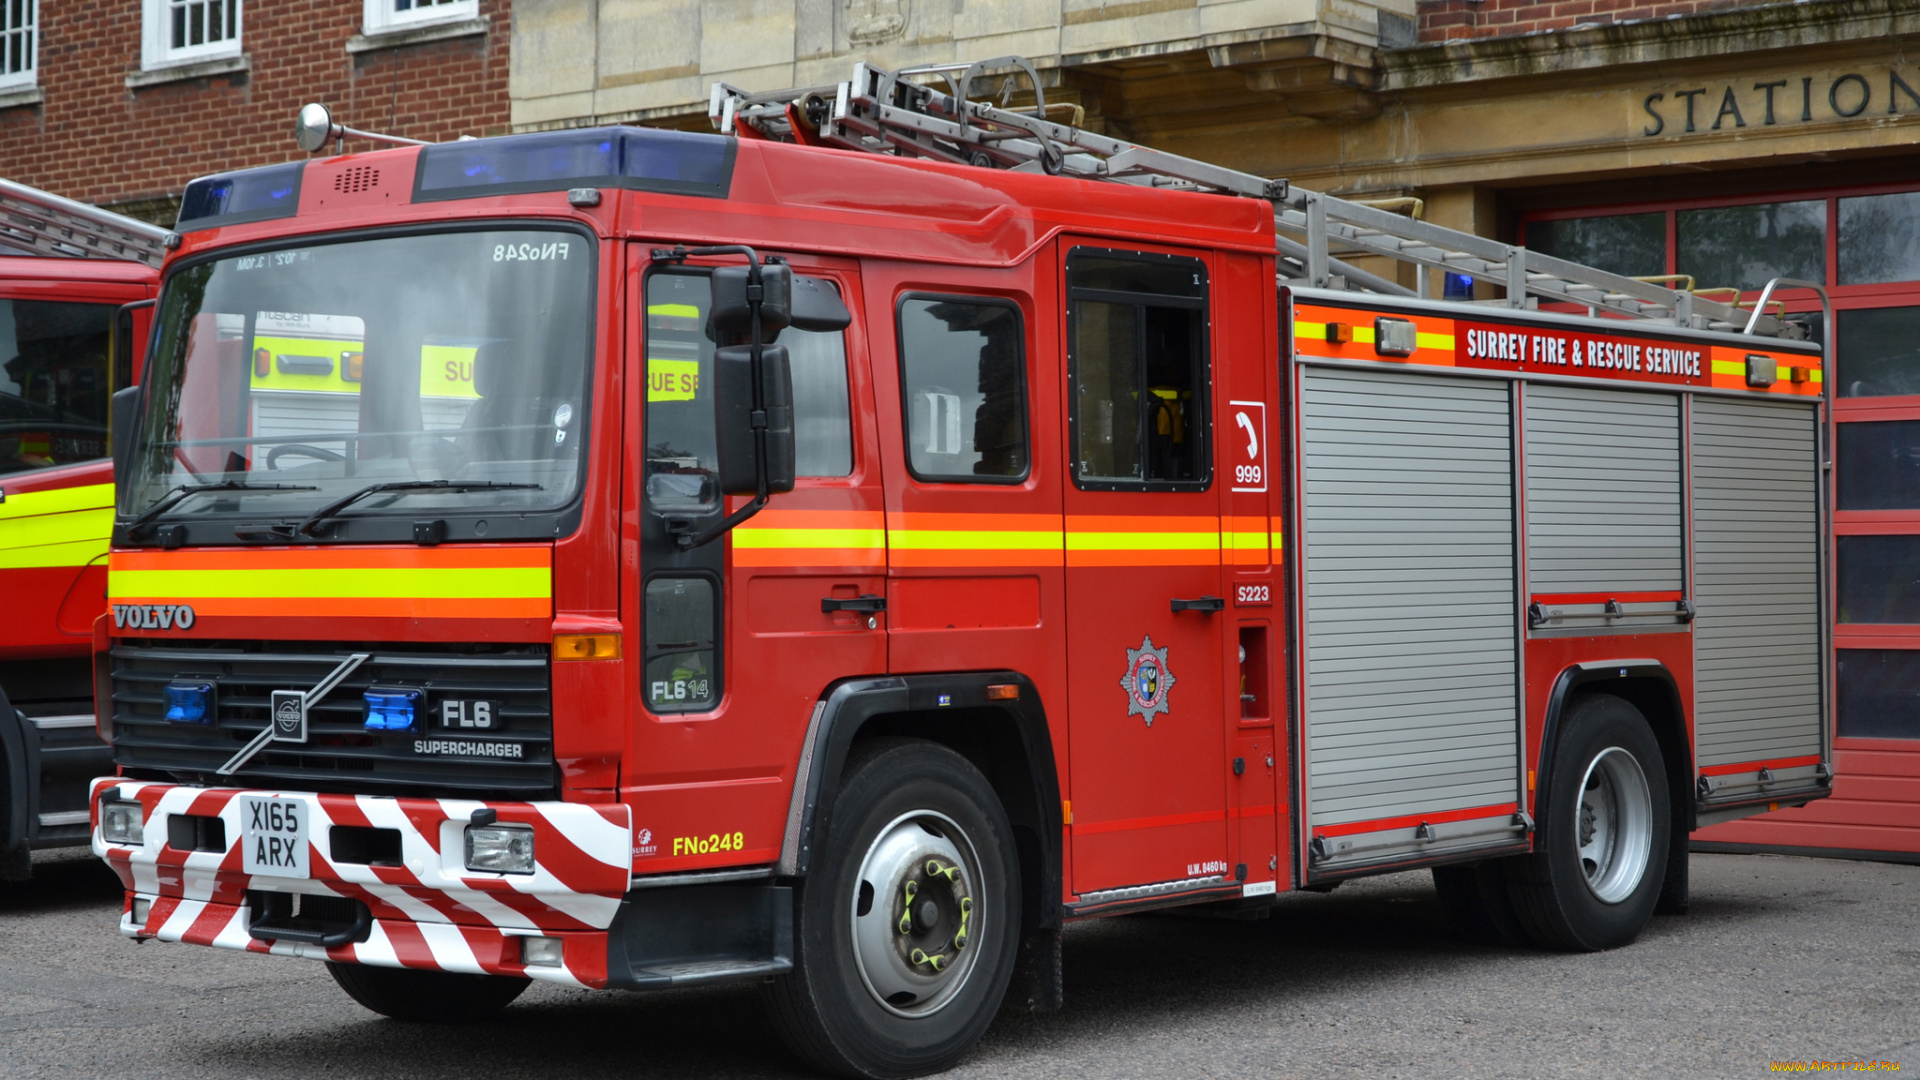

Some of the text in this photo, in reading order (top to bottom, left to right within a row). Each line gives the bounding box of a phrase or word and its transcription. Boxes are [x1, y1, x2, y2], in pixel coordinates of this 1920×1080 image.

[1644, 67, 1920, 137] STATION
[1467, 328, 1701, 377] SURREY FIRE & RESCUE SERVICE
[445, 361, 472, 381] SU
[1236, 465, 1261, 483] 999
[1238, 586, 1269, 602] S223
[112, 604, 195, 630] VOLVO
[652, 679, 709, 700] FL6 14
[442, 700, 491, 727] FL6
[414, 740, 522, 757] SUPERCHARGER
[250, 801, 298, 832] X165
[256, 836, 296, 868] ARX
[631, 845, 657, 854] SURREY
[673, 831, 744, 856] FNo248
[1202, 861, 1218, 873] 8460
[1219, 860, 1227, 872] kg
